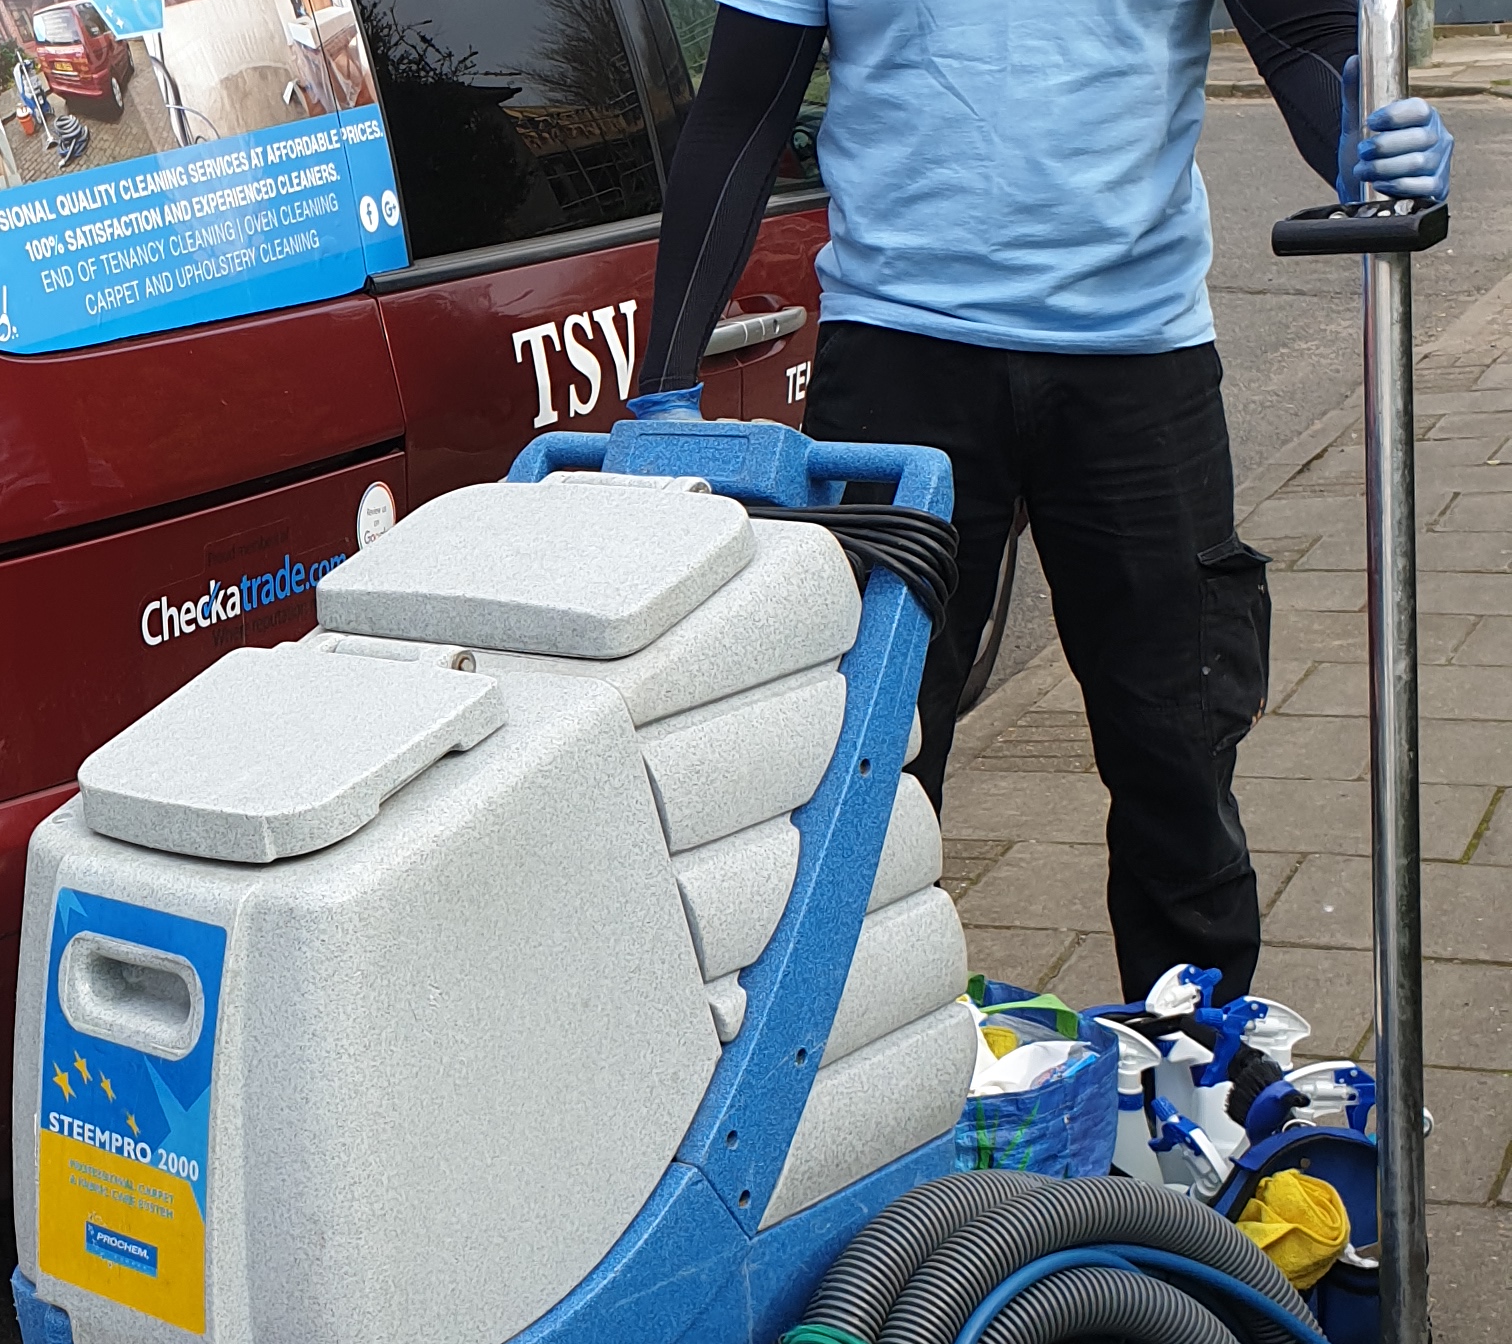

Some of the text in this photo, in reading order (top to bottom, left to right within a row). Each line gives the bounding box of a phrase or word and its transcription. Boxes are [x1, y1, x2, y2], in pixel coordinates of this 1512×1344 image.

[25, 162, 341, 263] 100% SATISFACTION AND EXPERIENCED CLEANERS.
[56, 182, 116, 224] QUALITY
[119, 165, 187, 201] CLEANING
[187, 151, 251, 184] SERVICES
[251, 146, 267, 169] AT
[266, 128, 341, 165] AFFORDABLE
[41, 265, 75, 294] END
[77, 258, 100, 283] OF
[100, 239, 166, 275] TENANCY
[169, 219, 237, 256] CLEANING
[245, 208, 279, 238] OVEN
[279, 192, 340, 228] CLEANING
[84, 229, 321, 316] CARPET AND UPHOLSTERY CLEANING
[510, 298, 638, 429] TSV
[49, 1111, 200, 1182] STEEMPRO 2000
[96, 1231, 148, 1258] PROCHEM
